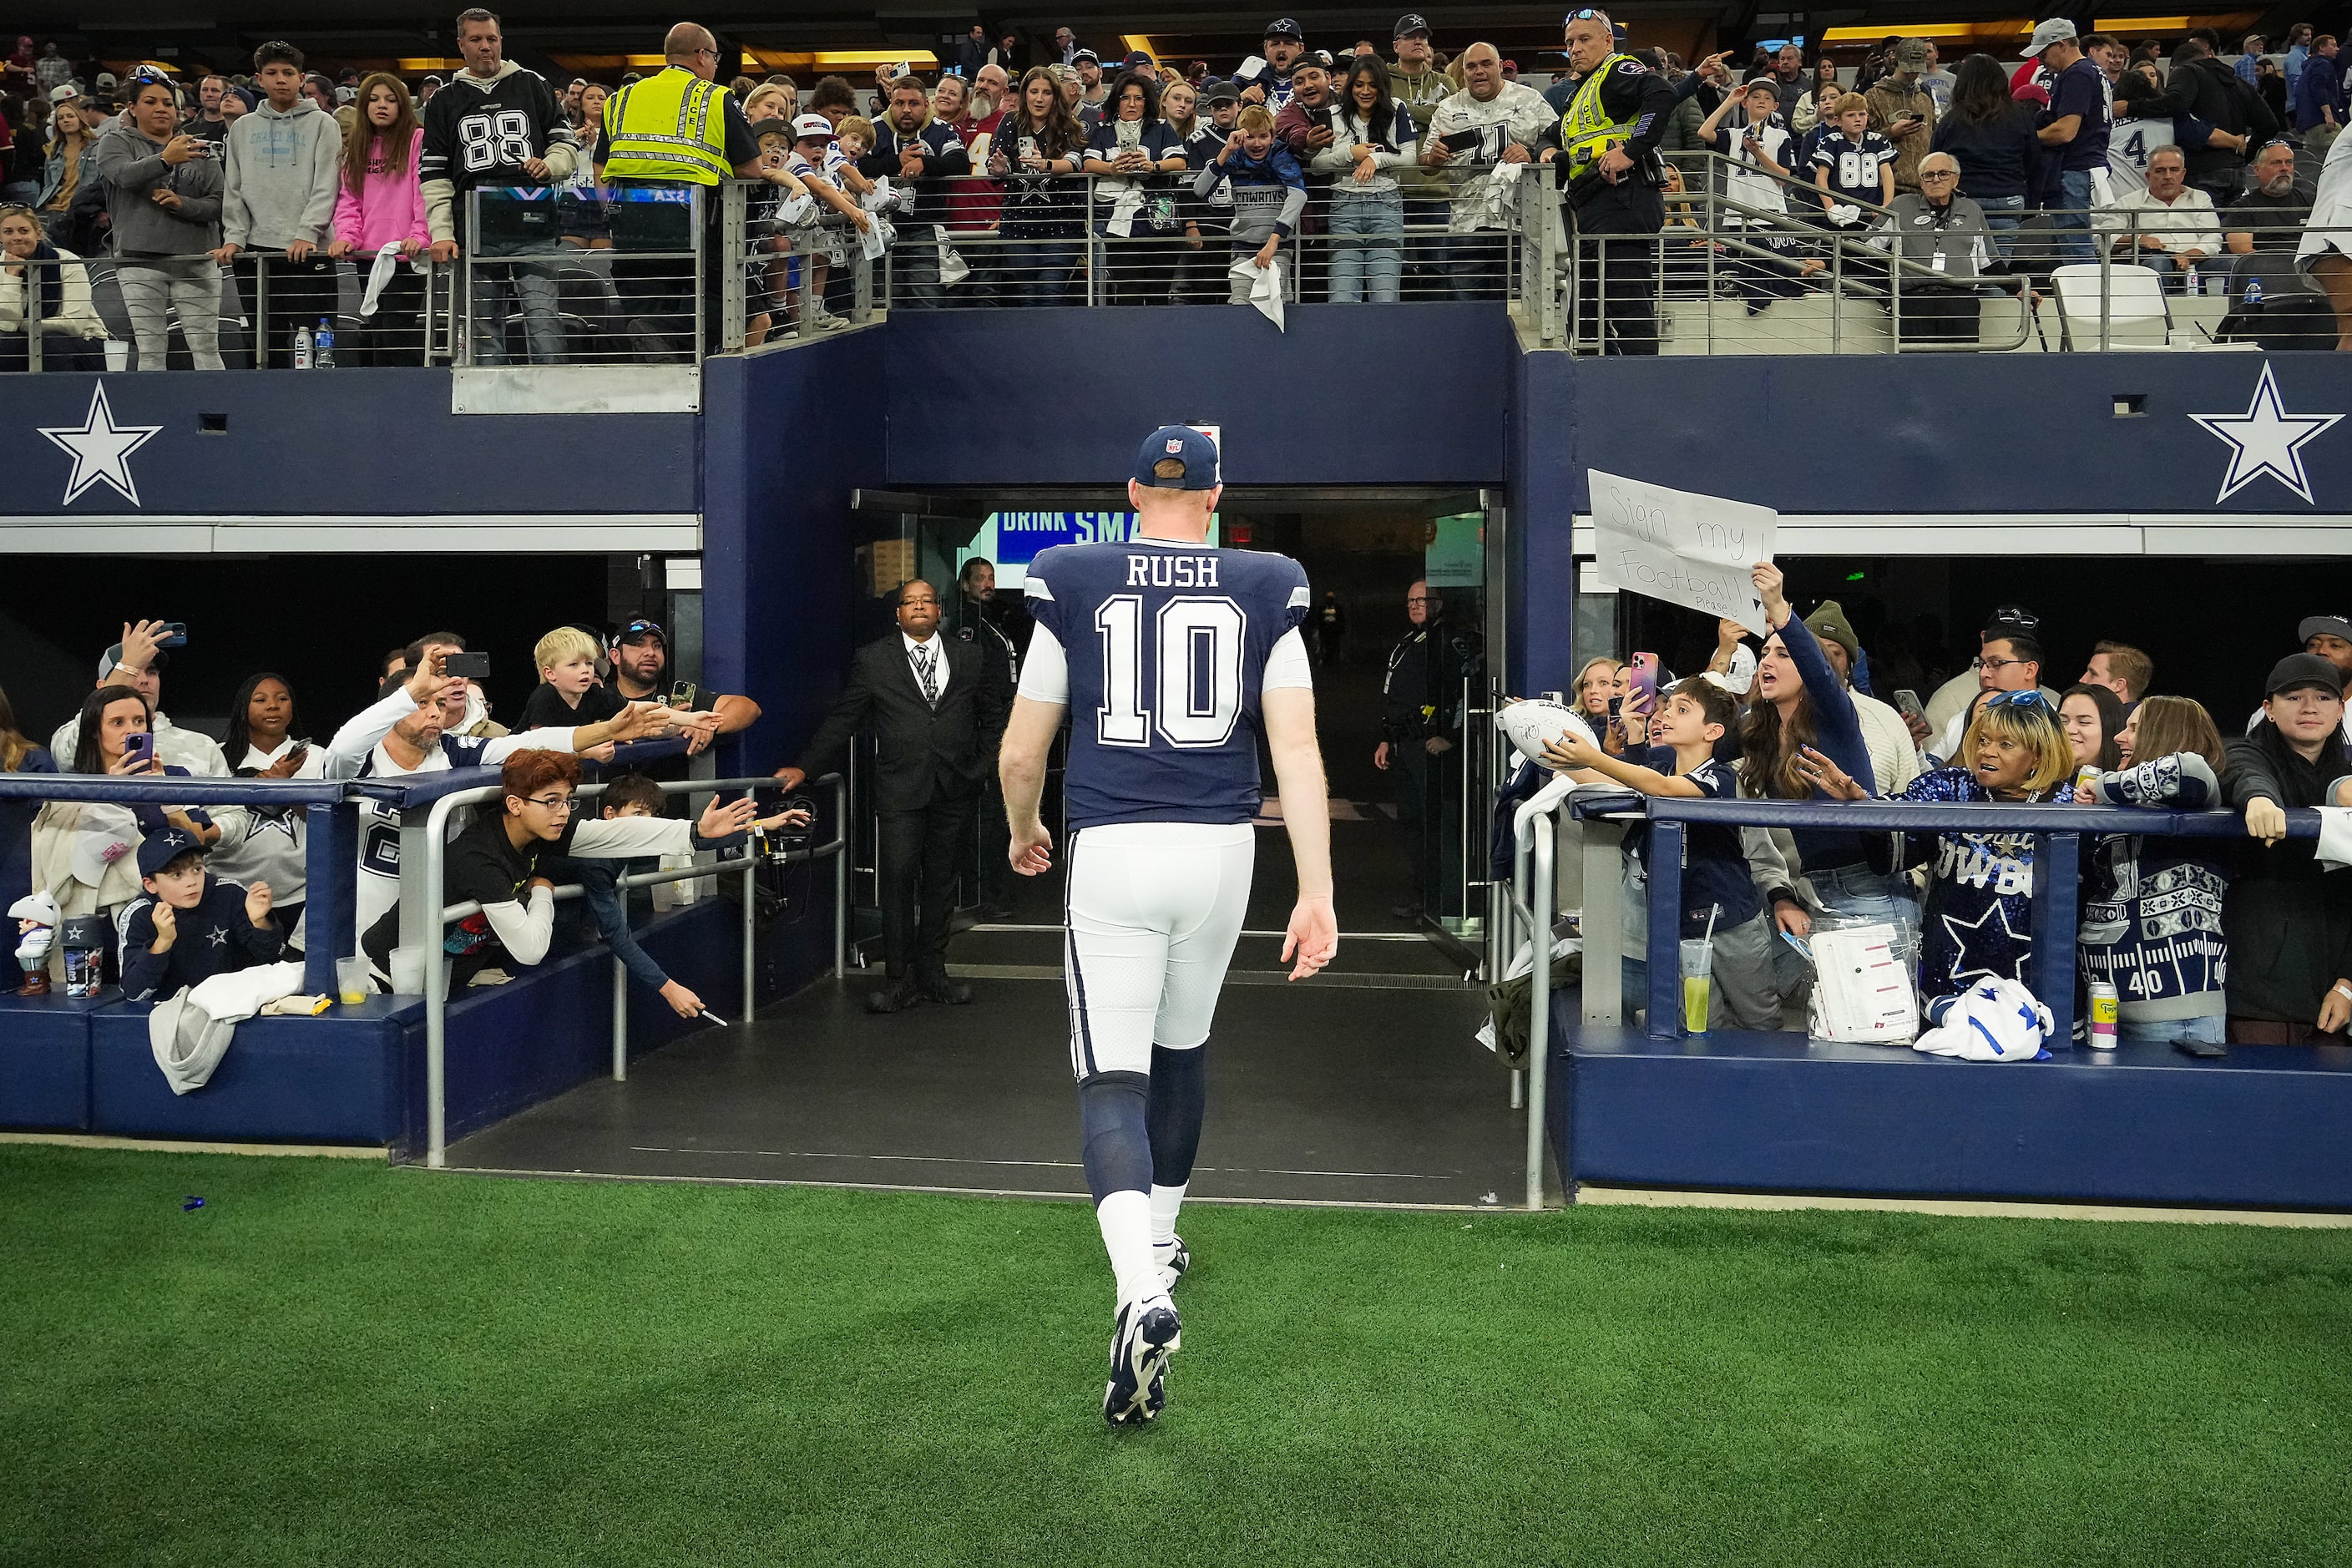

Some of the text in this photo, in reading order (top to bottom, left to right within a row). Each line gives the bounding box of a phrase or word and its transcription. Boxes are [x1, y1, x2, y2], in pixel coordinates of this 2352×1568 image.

[458, 109, 534, 172] 88
[1469, 121, 1509, 164] 11
[2122, 129, 2148, 169] 4
[1839, 152, 1879, 188] 88
[1236, 190, 1285, 207] COWBOYS
[1004, 512, 1068, 531] DRINK
[1610, 485, 1746, 561] Sign my
[1126, 554, 1219, 588] RUSH
[1616, 549, 1743, 604] Football
[1695, 595, 1728, 615] Please
[1095, 594, 1247, 749] 10
[2128, 969, 2163, 995] 40
